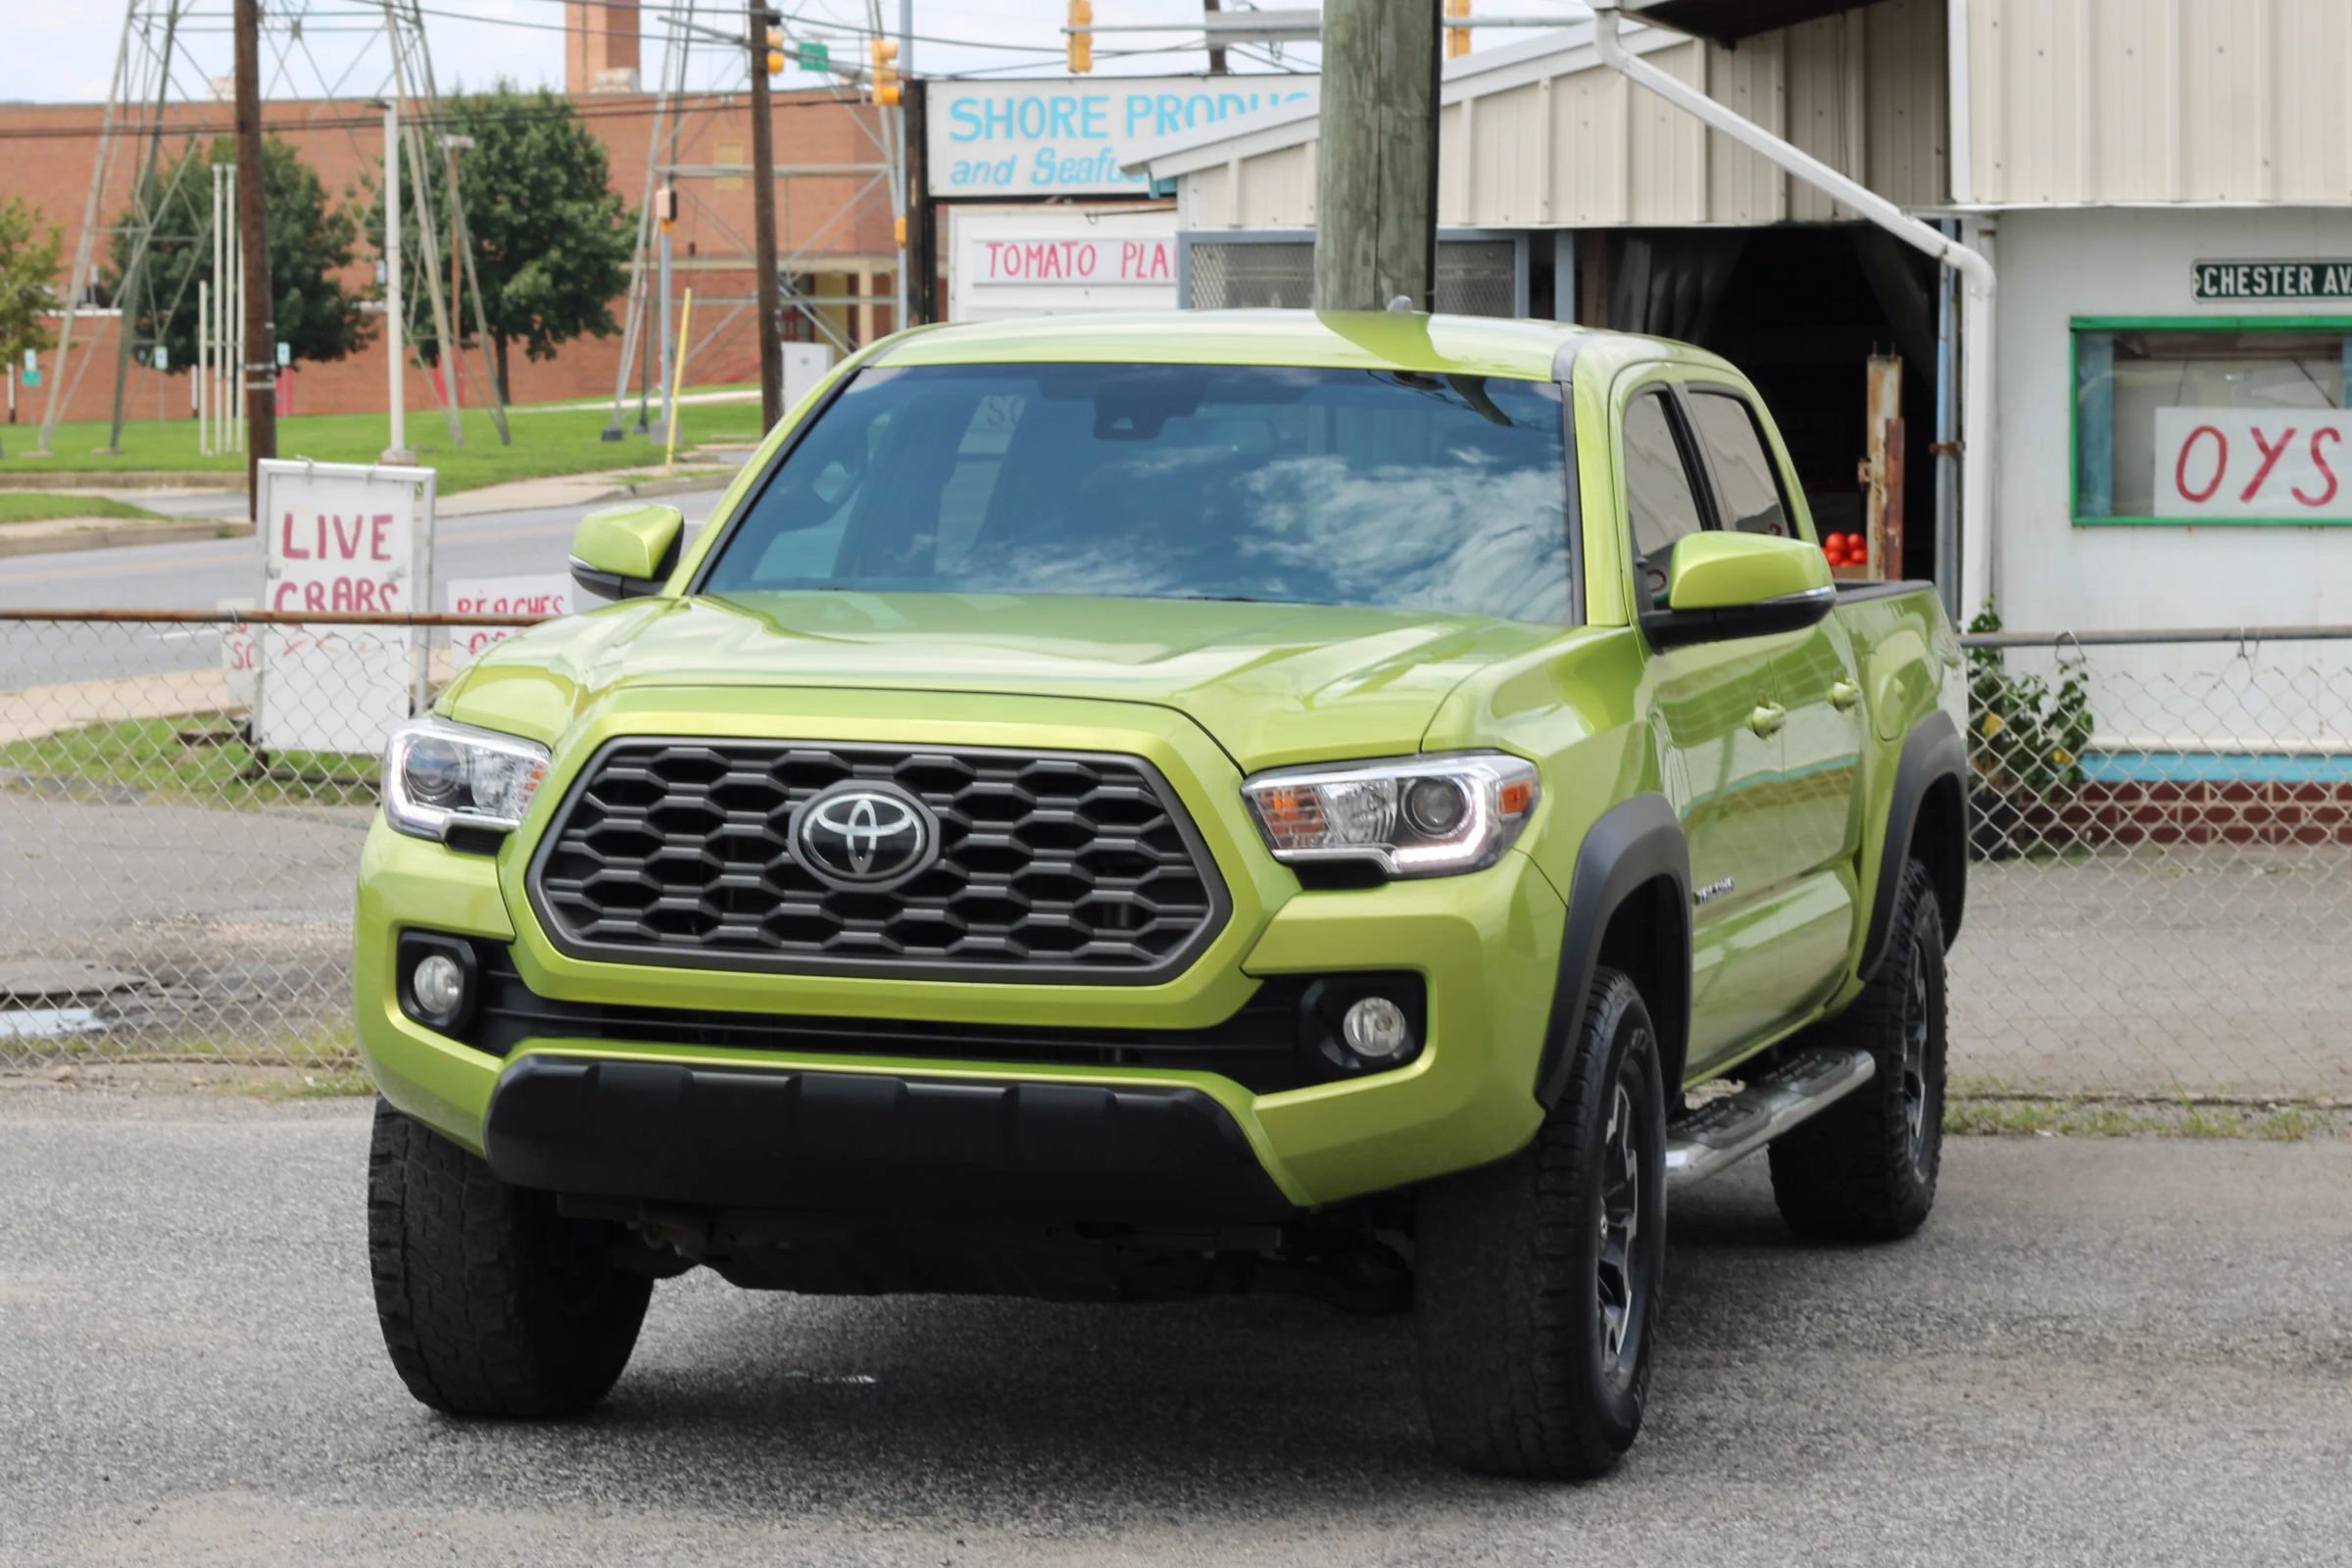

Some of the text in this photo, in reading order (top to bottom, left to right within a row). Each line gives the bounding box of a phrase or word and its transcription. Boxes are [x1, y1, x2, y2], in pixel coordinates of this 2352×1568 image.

[949, 95, 1109, 142] SHORE
[950, 153, 1018, 186] and
[986, 240, 1176, 279] TOMATO PLA
[2203, 266, 2315, 295] CHESTER
[2175, 424, 2342, 508] OYS
[281, 512, 394, 562] LIVE
